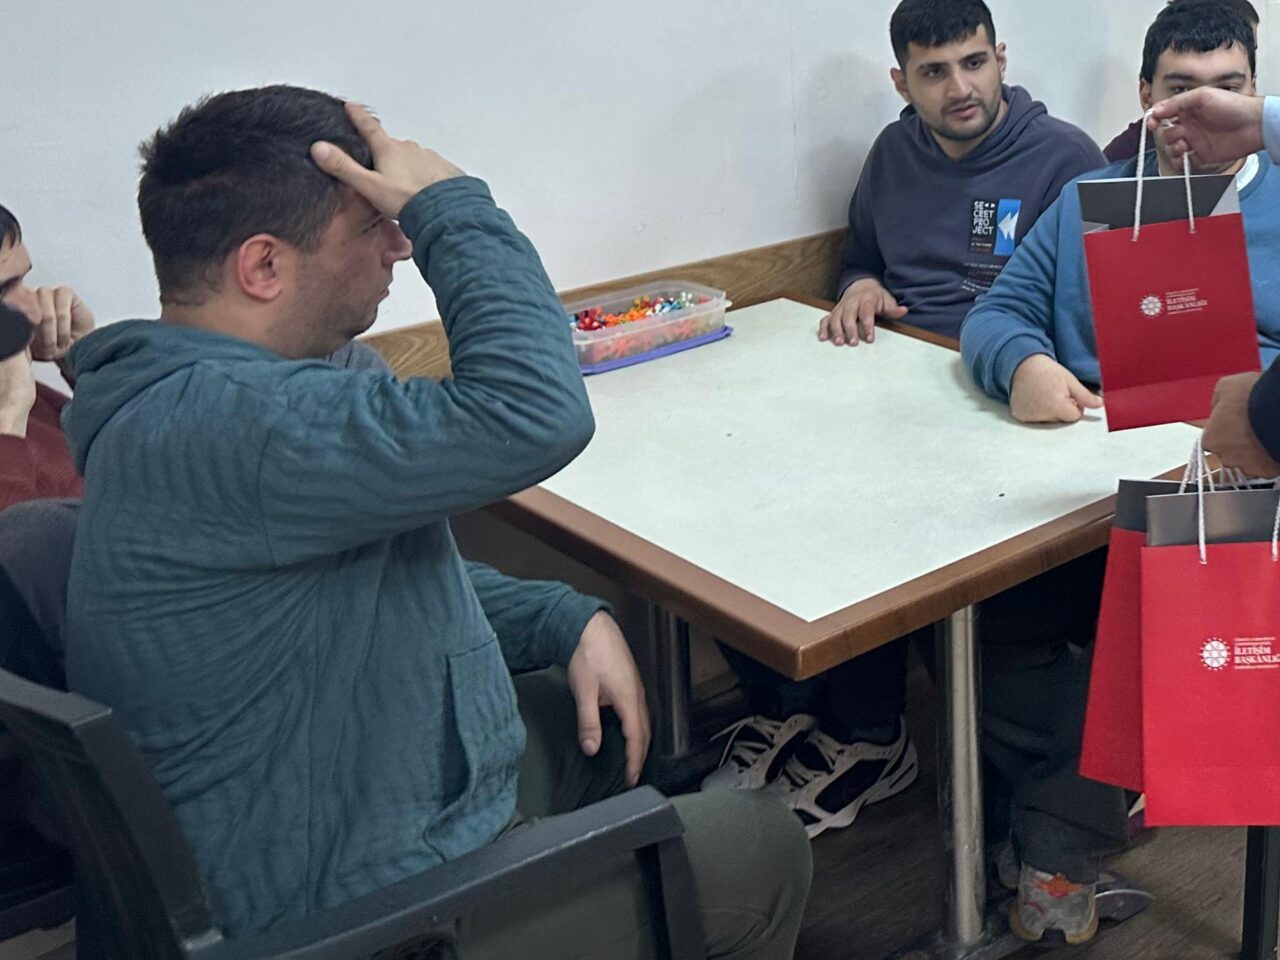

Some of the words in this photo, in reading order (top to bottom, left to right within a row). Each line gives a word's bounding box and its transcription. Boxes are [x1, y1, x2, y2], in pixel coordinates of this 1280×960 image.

[974, 201, 984, 210] SE
[973, 210, 995, 218] CRET
[973, 218, 990, 226] PRO
[972, 226, 994, 235] JECT
